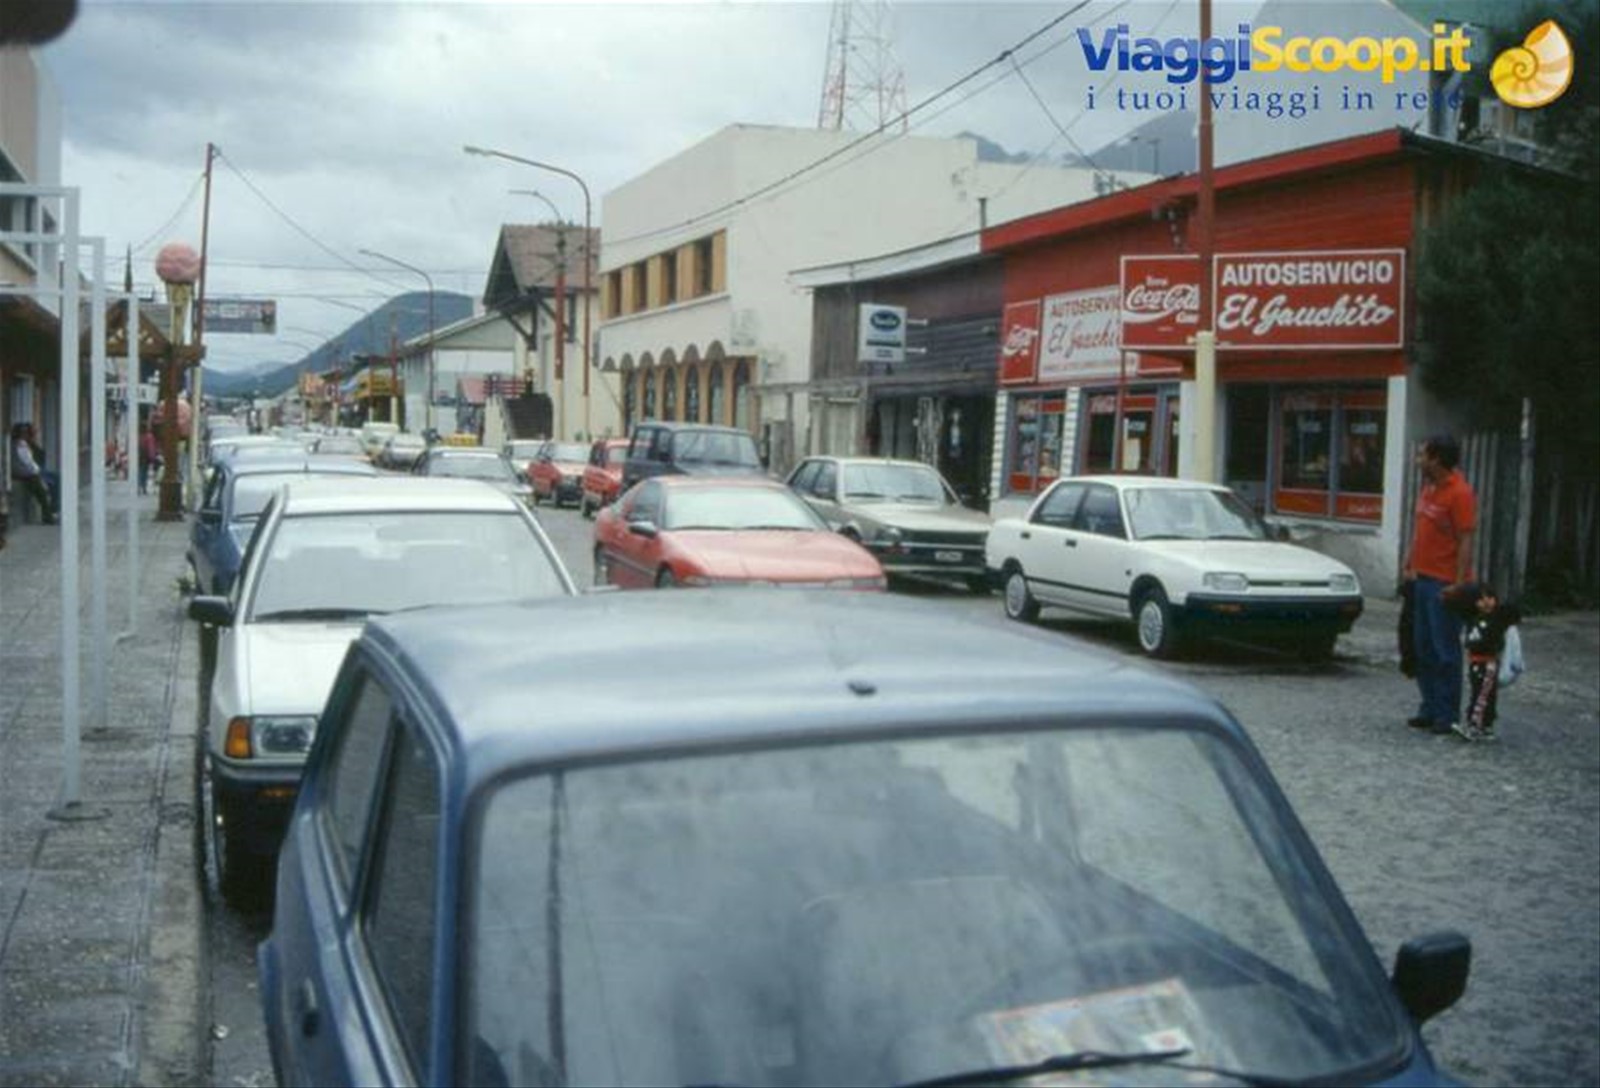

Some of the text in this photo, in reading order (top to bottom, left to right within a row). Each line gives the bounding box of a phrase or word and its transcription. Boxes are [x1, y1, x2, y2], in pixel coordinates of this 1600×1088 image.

[1222, 260, 1393, 286] AUTOSERVICIO
[1218, 293, 1395, 336] El Gauchito
